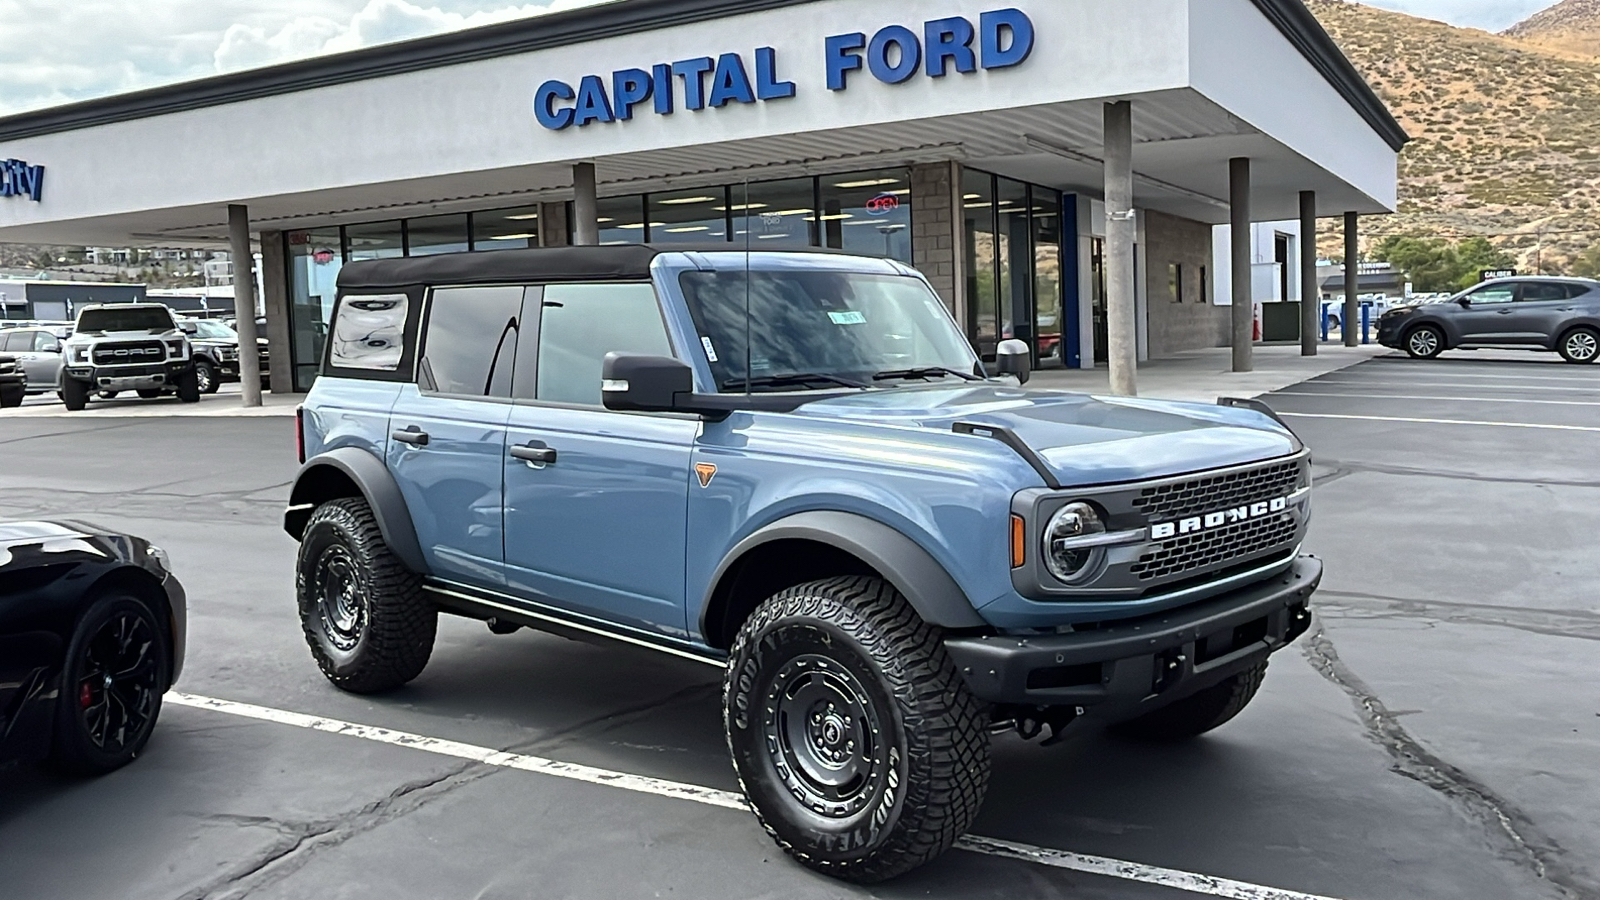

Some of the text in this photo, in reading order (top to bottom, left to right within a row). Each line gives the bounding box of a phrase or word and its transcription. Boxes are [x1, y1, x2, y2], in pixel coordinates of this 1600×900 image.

[534, 7, 1034, 131] CAPITAL FORD
[866, 198, 898, 211] OPEN
[1484, 270, 1512, 278] CALIBER
[95, 347, 161, 357] FORD
[1151, 496, 1286, 539] BRONCO
